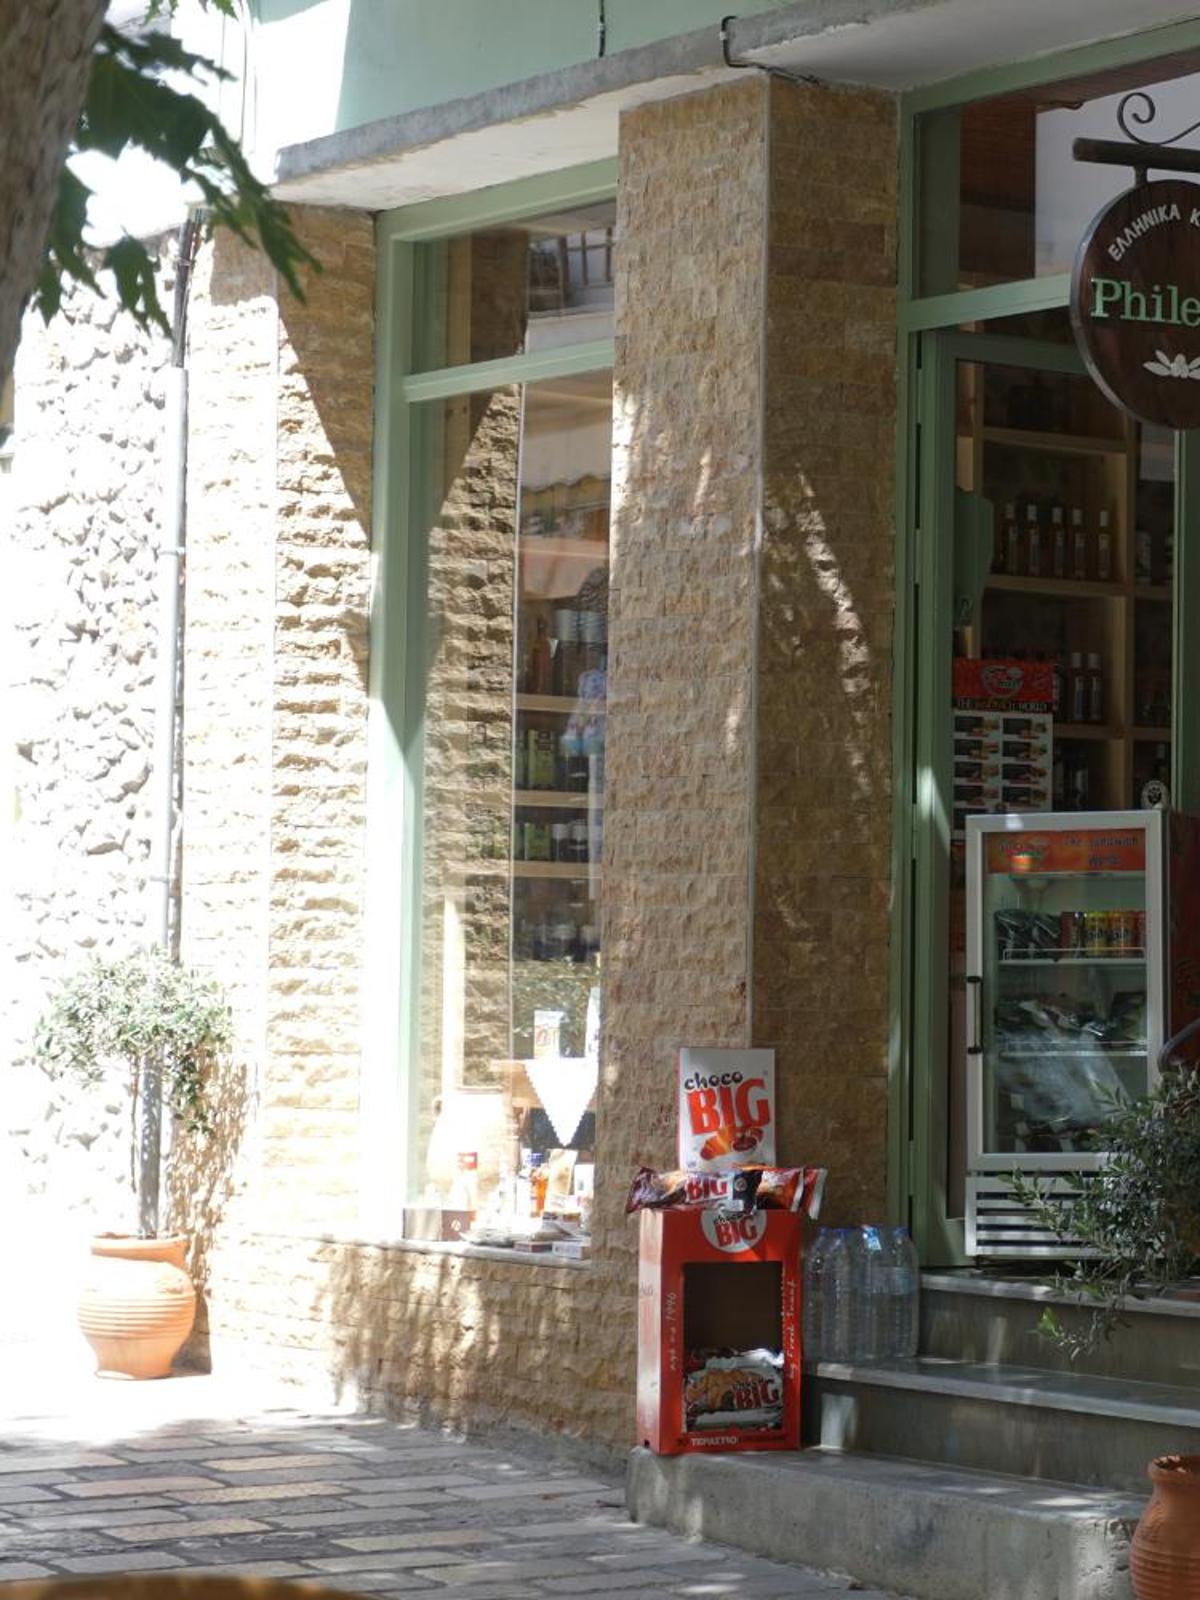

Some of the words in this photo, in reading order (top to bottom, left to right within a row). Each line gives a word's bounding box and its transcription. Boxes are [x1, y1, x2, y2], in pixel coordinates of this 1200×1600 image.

[1107, 203, 1181, 262] ΕΛΛΗΝΙΚΑ
[684, 1070, 744, 1090] choco
[687, 1078, 770, 1135] BIG
[714, 1214, 758, 1247] BIG
